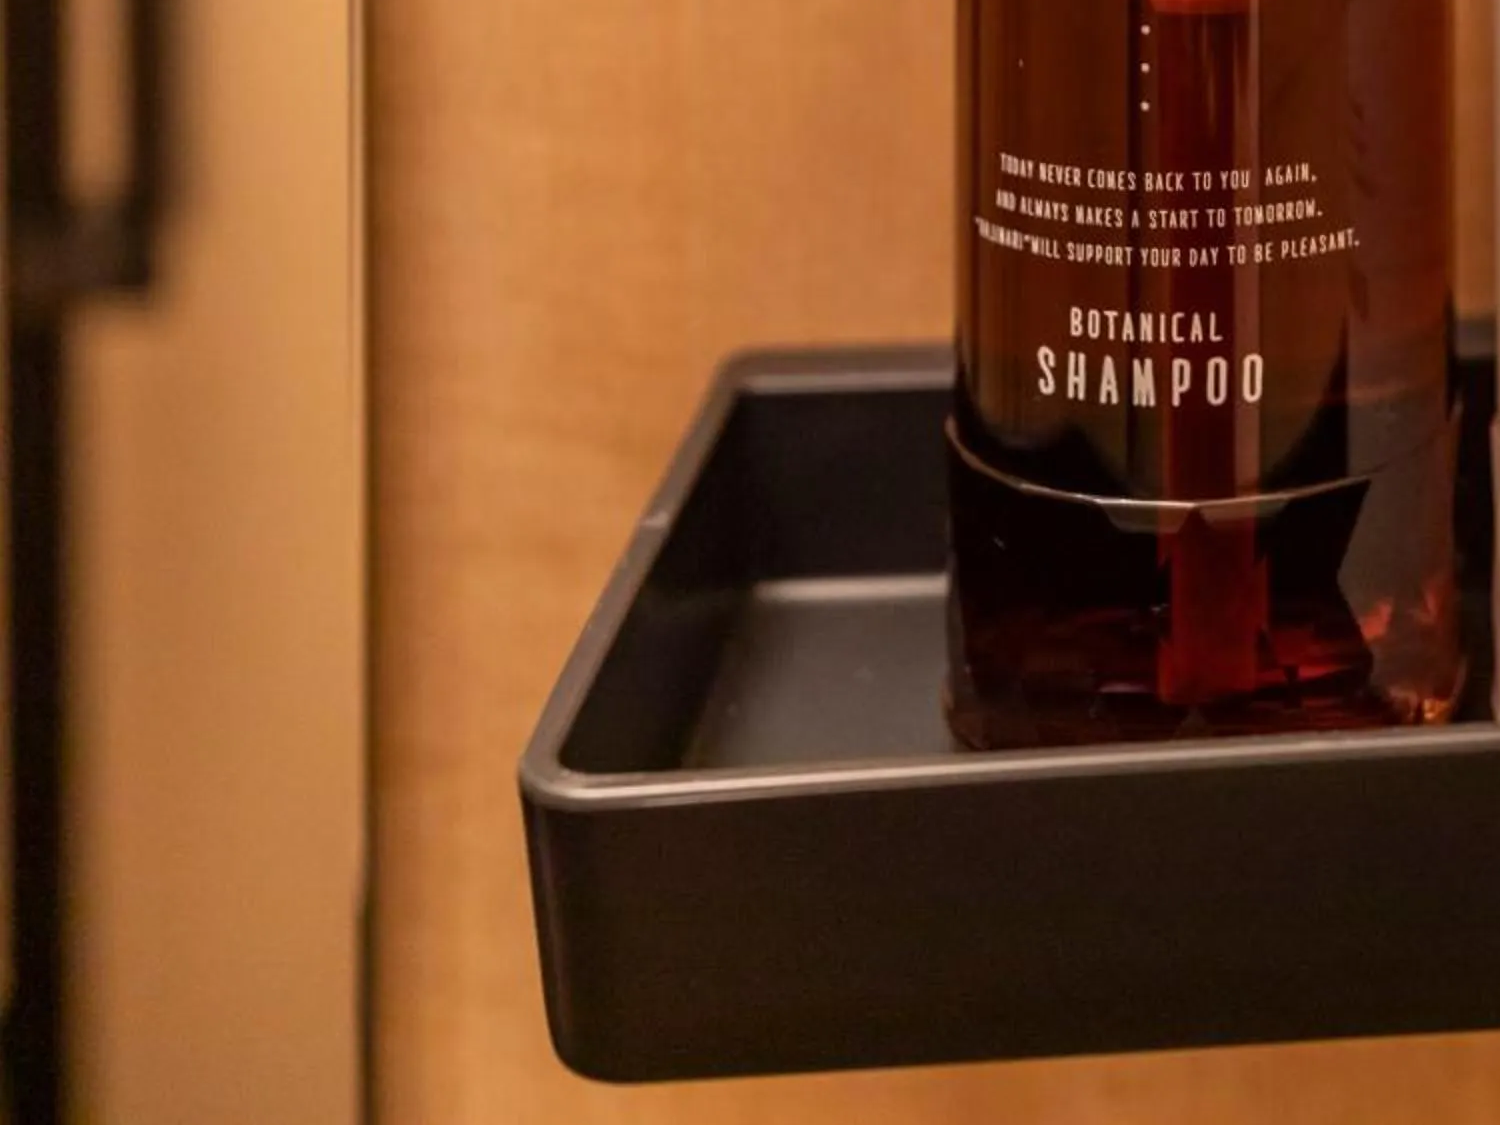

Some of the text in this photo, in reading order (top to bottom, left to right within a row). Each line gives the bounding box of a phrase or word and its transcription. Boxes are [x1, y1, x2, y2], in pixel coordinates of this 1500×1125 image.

[1000, 152, 1318, 192] TODAY NEVER COMES BACK TO YOU AGAIN.
[995, 188, 1323, 230] AND ALWAYS MAKES A START TO TOMORROW.
[1067, 240, 1133, 266] SUPPORT
[1140, 247, 1181, 268] YOUR
[1189, 247, 1219, 267] DAY
[1227, 244, 1246, 265] TO
[1254, 242, 1274, 264] BE
[1281, 228, 1360, 259] PLEASANT.
[1069, 306, 1224, 344] BOTANICAL
[1036, 345, 1264, 407] SHAMPOO
